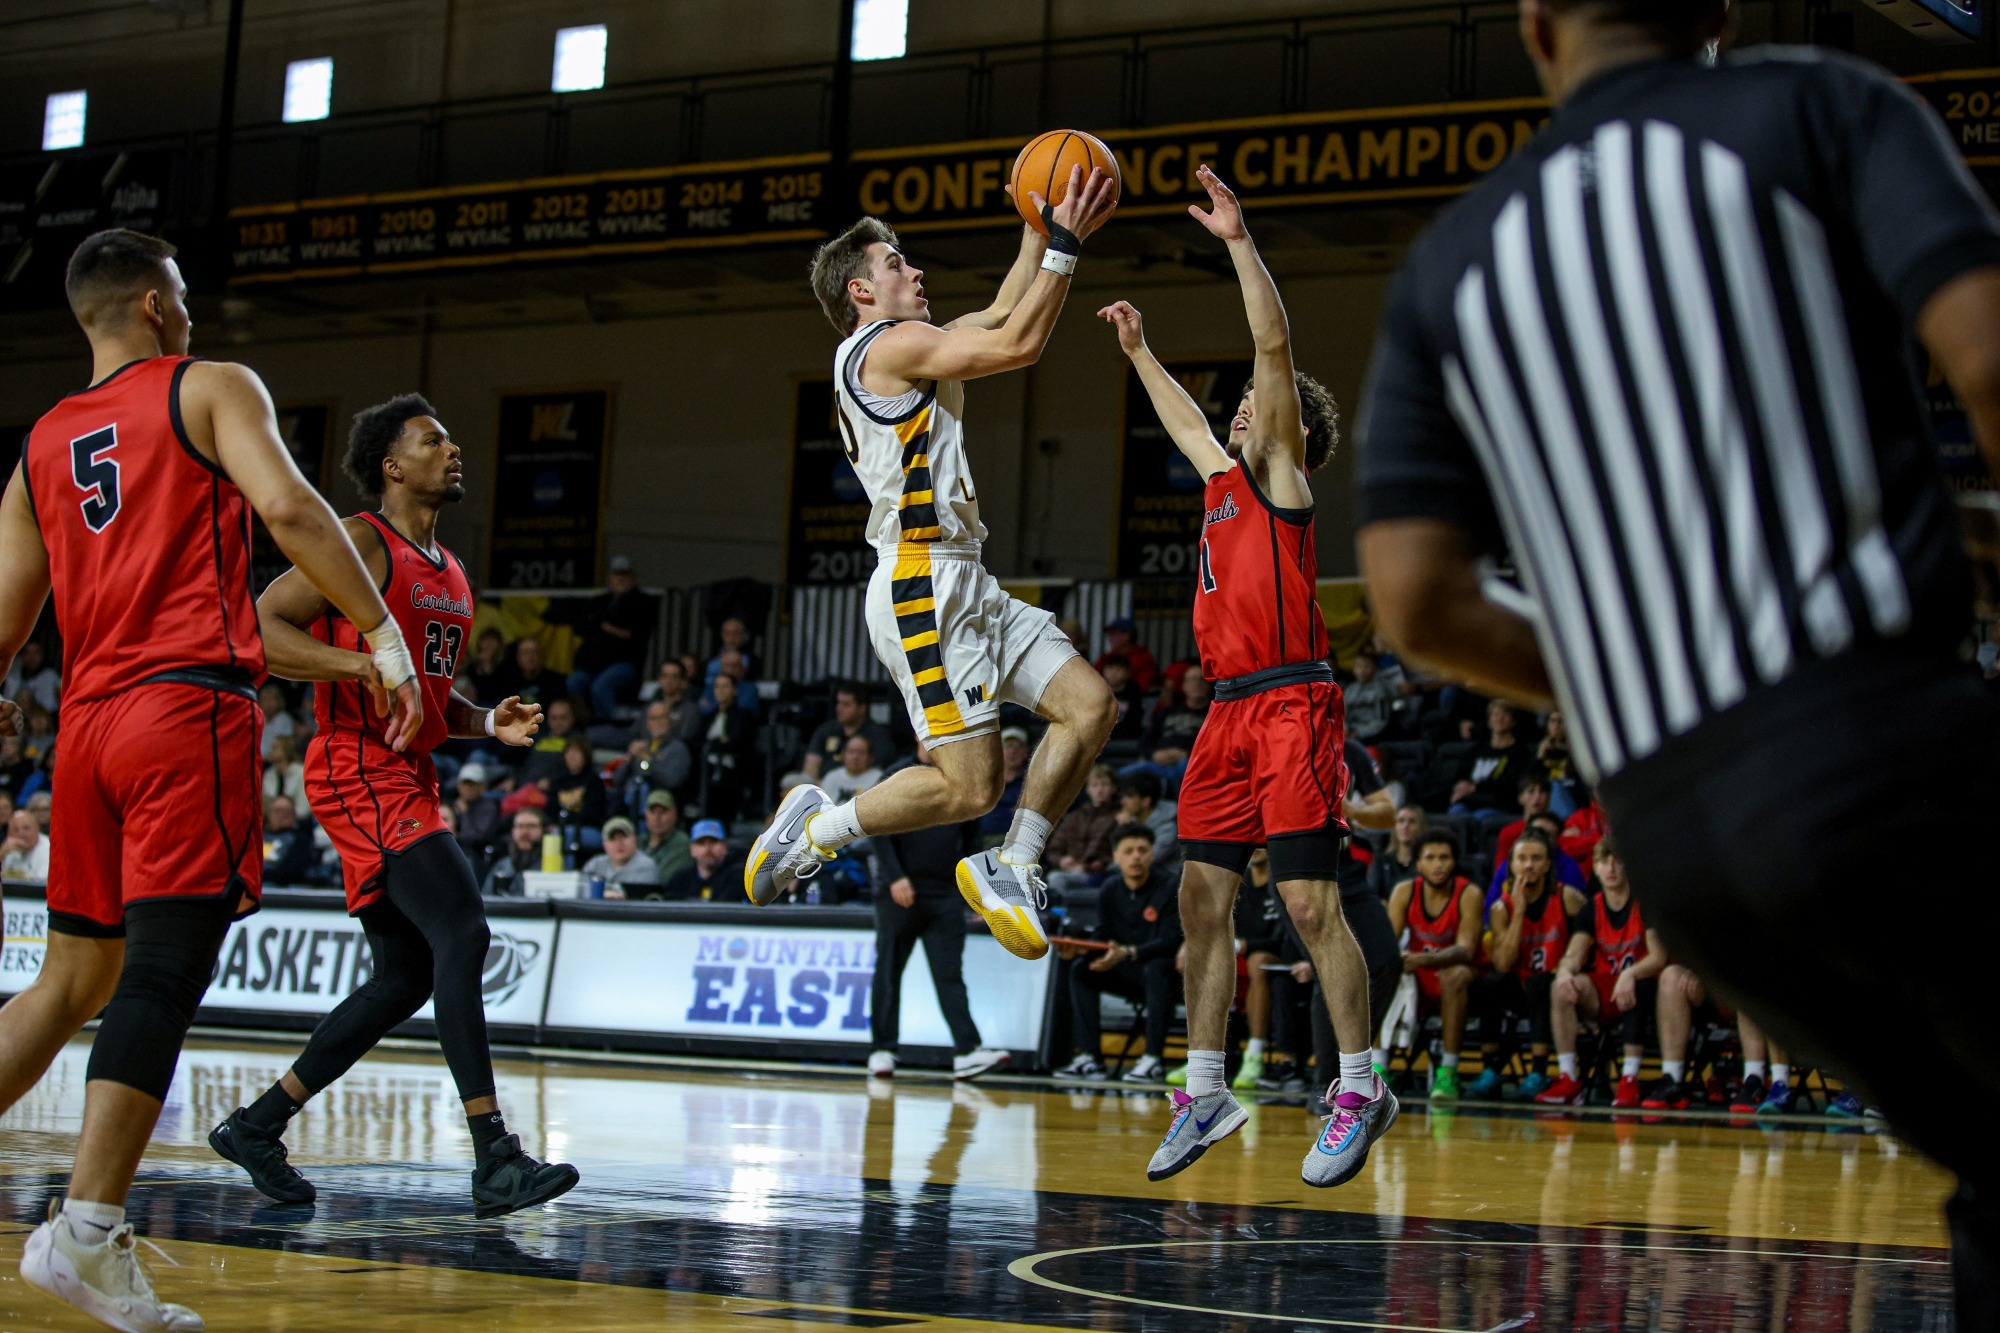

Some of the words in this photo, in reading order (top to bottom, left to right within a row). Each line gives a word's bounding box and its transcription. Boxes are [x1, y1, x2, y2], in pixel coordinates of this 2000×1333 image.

[678, 178, 745, 210] 2014
[760, 171, 825, 203] 2015
[859, 141, 1220, 216] CONFNCE
[454, 200, 509, 228] 2011
[529, 192, 591, 222] 2012
[603, 184, 667, 215] 2013
[766, 199, 815, 224] MEC
[379, 206, 437, 236] 2010
[686, 205, 735, 230] MEC
[70, 422, 121, 534] 5
[509, 558, 577, 588] 2014
[1139, 542, 1198, 575] 201
[410, 582, 472, 619] Cardinals
[423, 620, 463, 679] 23
[212, 926, 374, 995] ASKETB
[686, 964, 876, 1031] EAST
